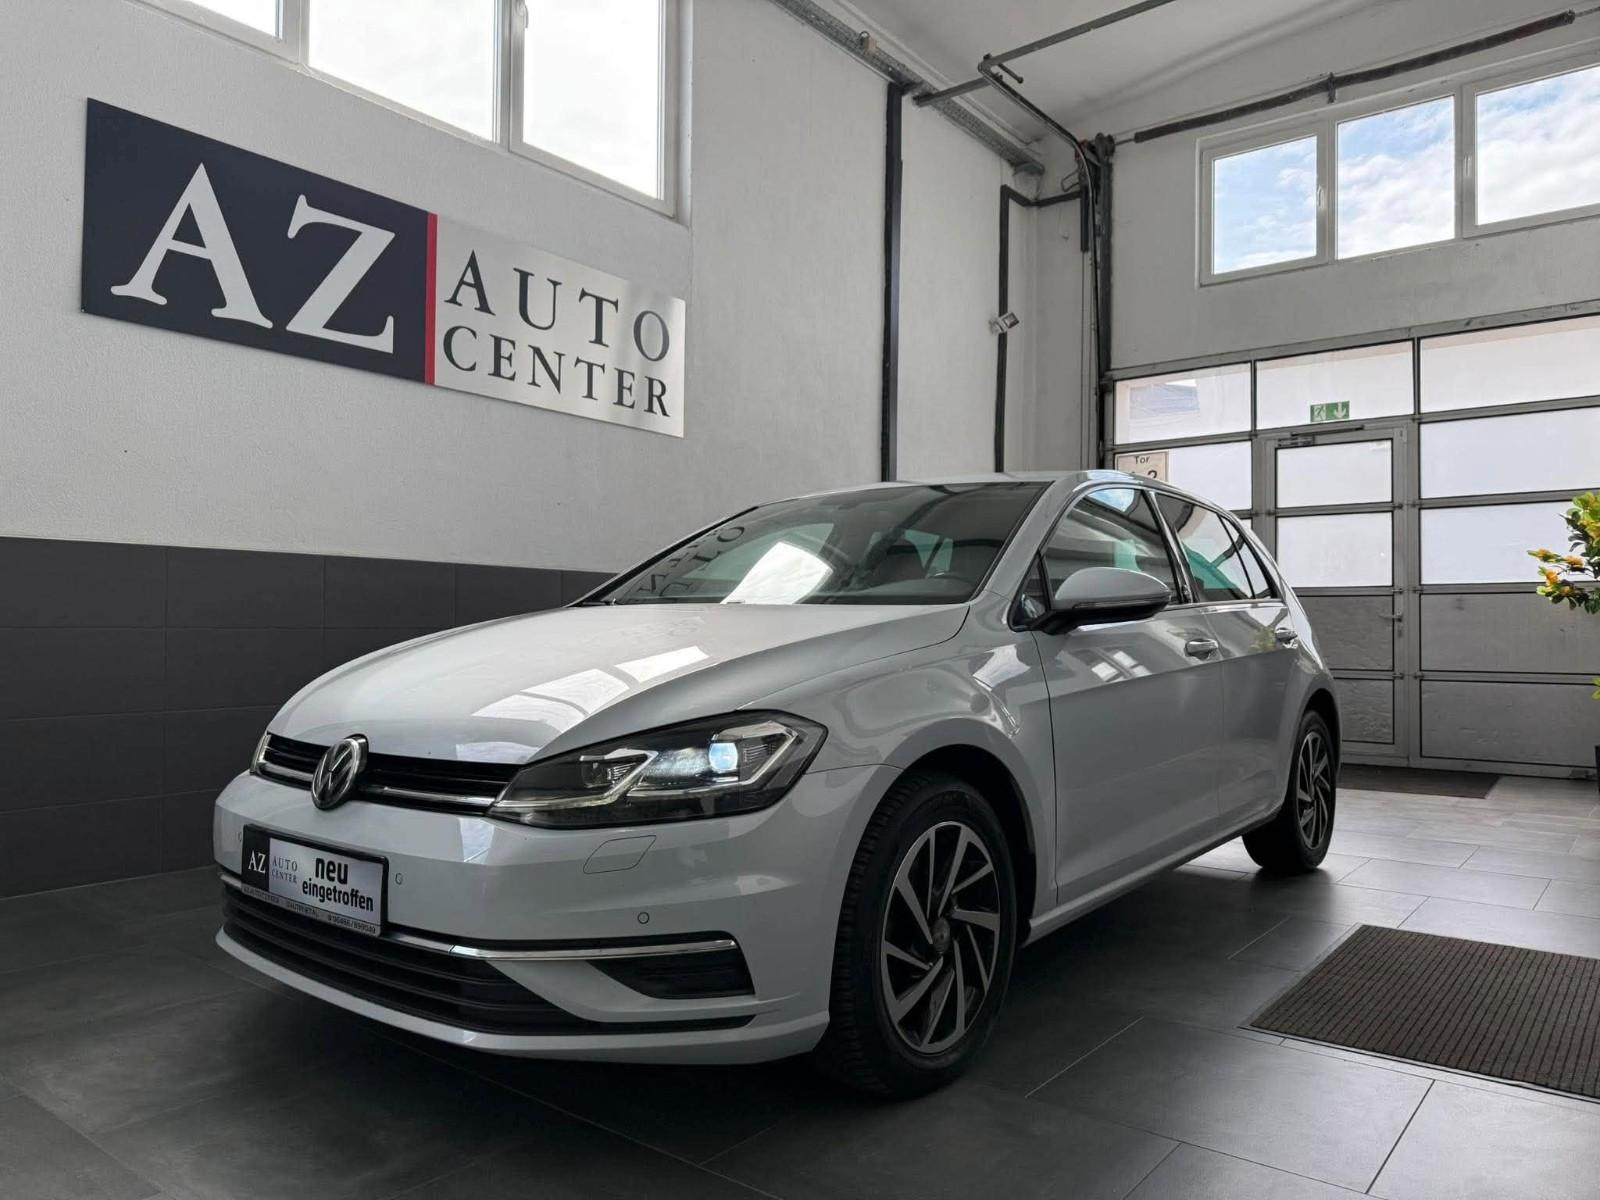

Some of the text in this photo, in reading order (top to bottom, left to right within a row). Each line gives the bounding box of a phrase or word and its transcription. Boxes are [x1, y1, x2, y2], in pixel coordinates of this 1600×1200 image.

[110, 162, 395, 354] AZ
[444, 249, 670, 362] AUTO
[443, 325, 671, 417] CENTER
[1135, 455, 1150, 464] Tor
[248, 849, 266, 874] AZ
[272, 855, 298, 872] AUTO
[315, 857, 348, 884] neu
[271, 868, 298, 884] CENTER
[302, 878, 374, 912] eingetroffen
